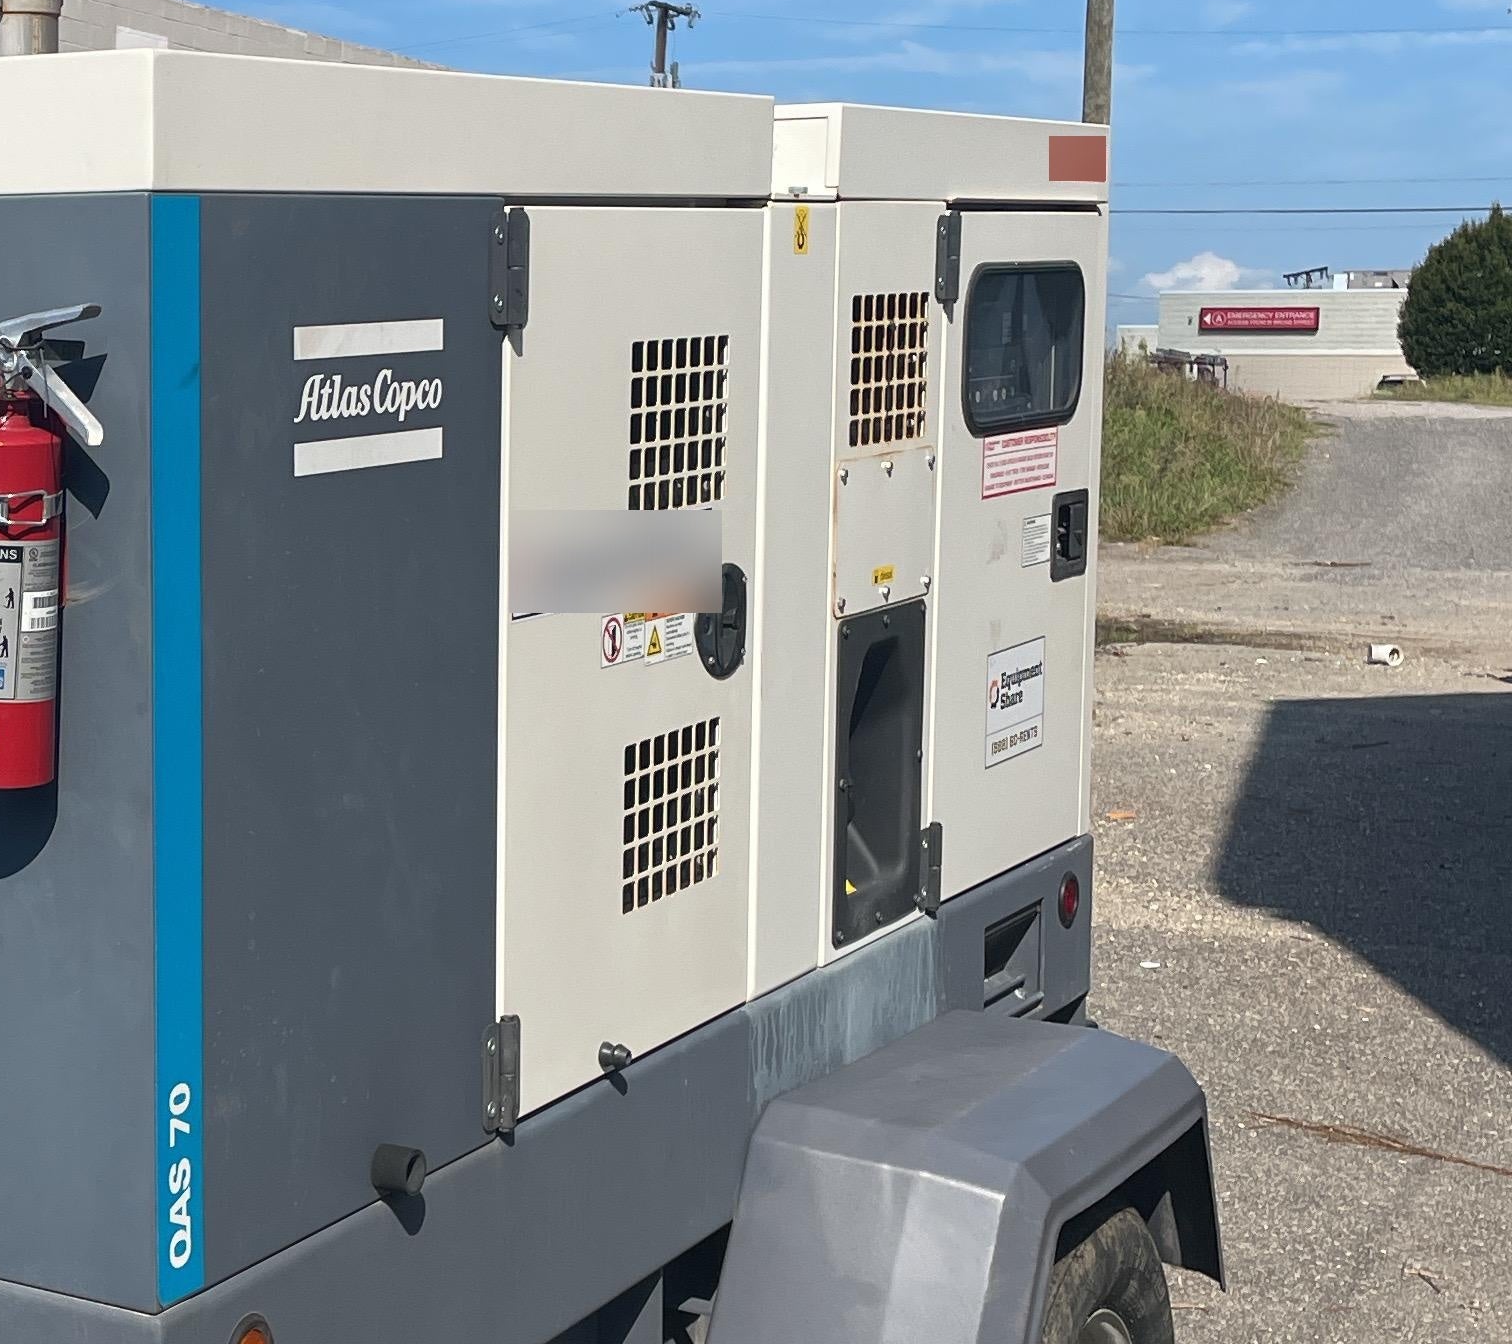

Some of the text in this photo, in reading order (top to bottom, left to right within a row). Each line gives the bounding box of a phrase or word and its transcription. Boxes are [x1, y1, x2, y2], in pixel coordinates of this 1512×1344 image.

[1227, 311, 1315, 319] EMERGENCY ENTRANCE
[293, 368, 443, 423] Atlas Copco
[1000, 660, 1043, 691] Equipment
[1000, 691, 1024, 710] Share
[168, 1082, 191, 1148] 70
